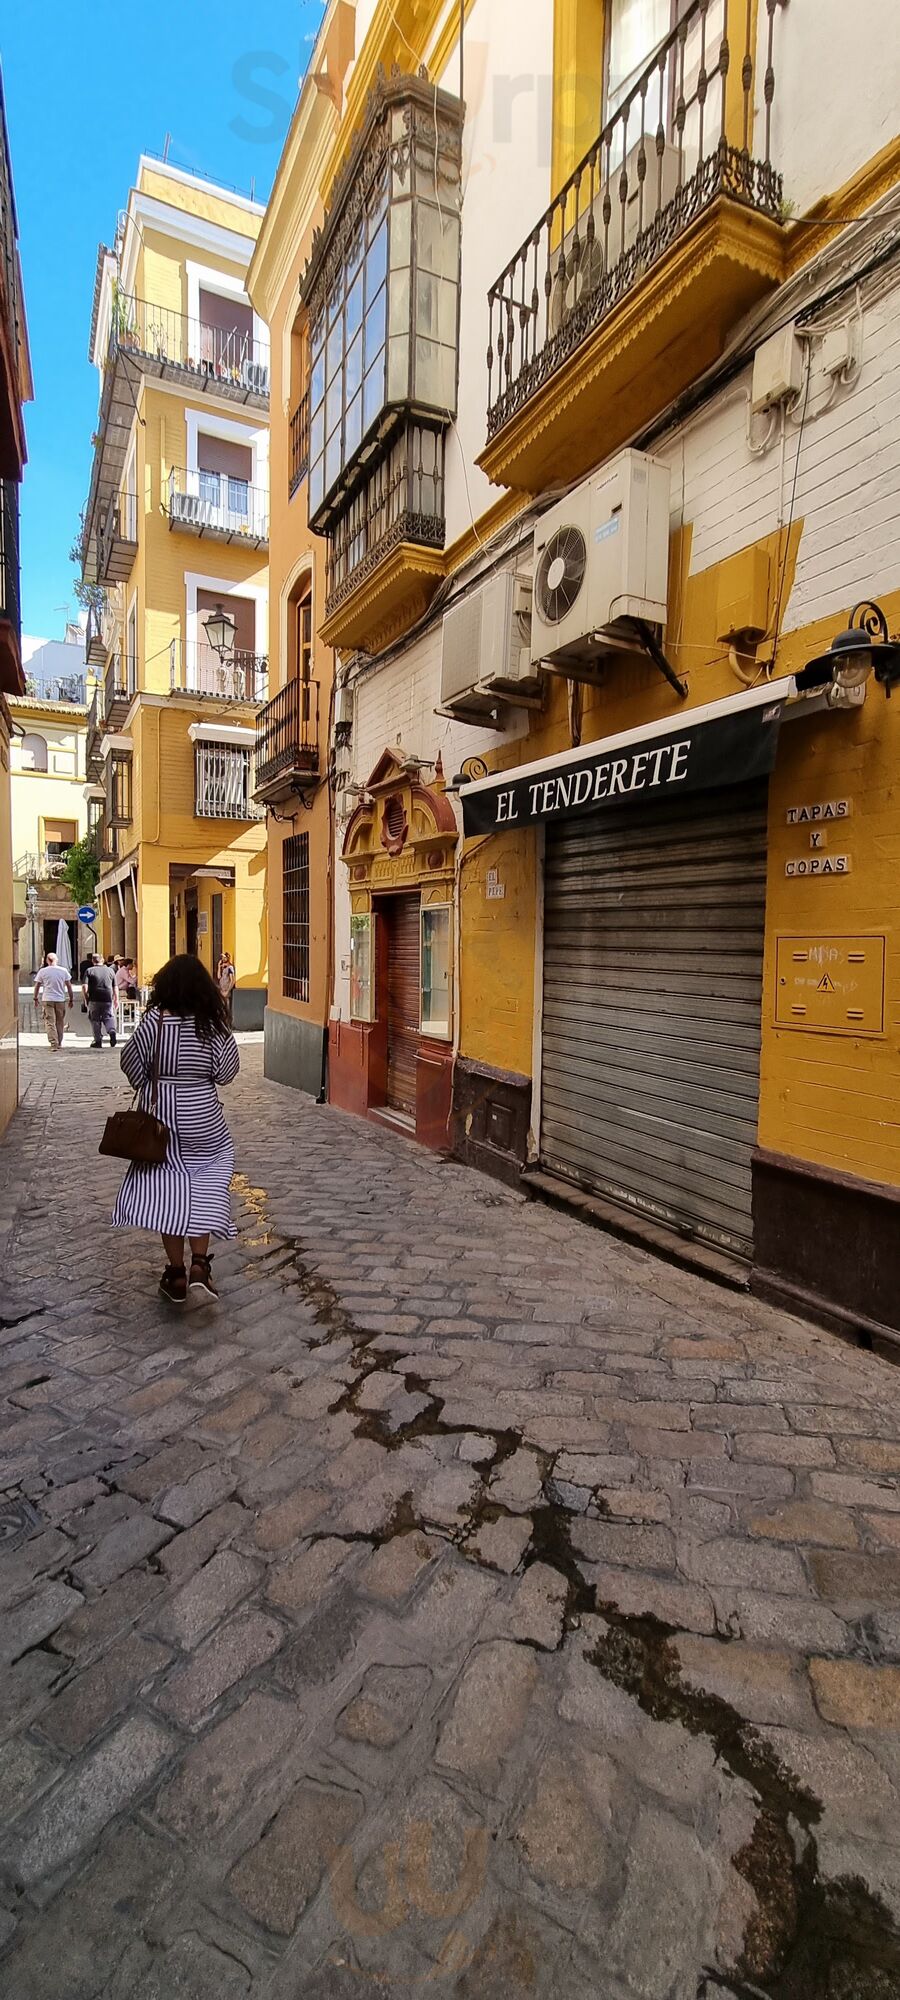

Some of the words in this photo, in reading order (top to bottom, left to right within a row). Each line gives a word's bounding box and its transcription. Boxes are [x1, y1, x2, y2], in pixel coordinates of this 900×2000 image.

[495, 790, 519, 823] EL
[528, 740, 692, 815] TENDERETE
[787, 802, 847, 823] TAPAS
[811, 833, 821, 847] Y
[786, 857, 846, 875] COPAS
